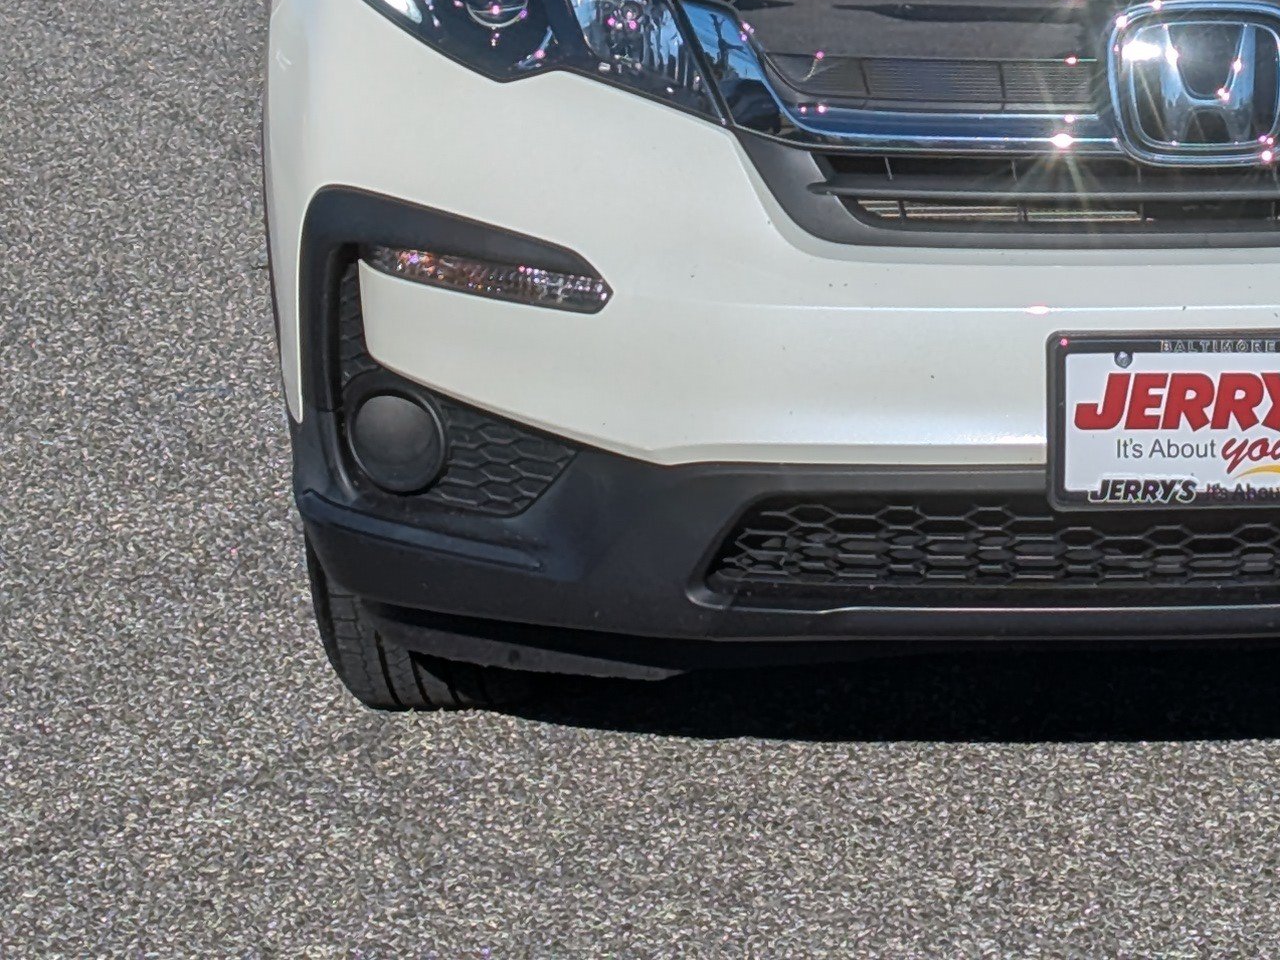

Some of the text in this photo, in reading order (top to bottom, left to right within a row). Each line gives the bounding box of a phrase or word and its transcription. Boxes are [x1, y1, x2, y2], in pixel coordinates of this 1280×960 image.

[1160, 339, 1276, 353] BALTIMORE
[1116, 437, 1143, 459] It's
[1149, 437, 1217, 459] About
[1088, 477, 1198, 503] JERRY'S
[1206, 482, 1227, 498] It's
